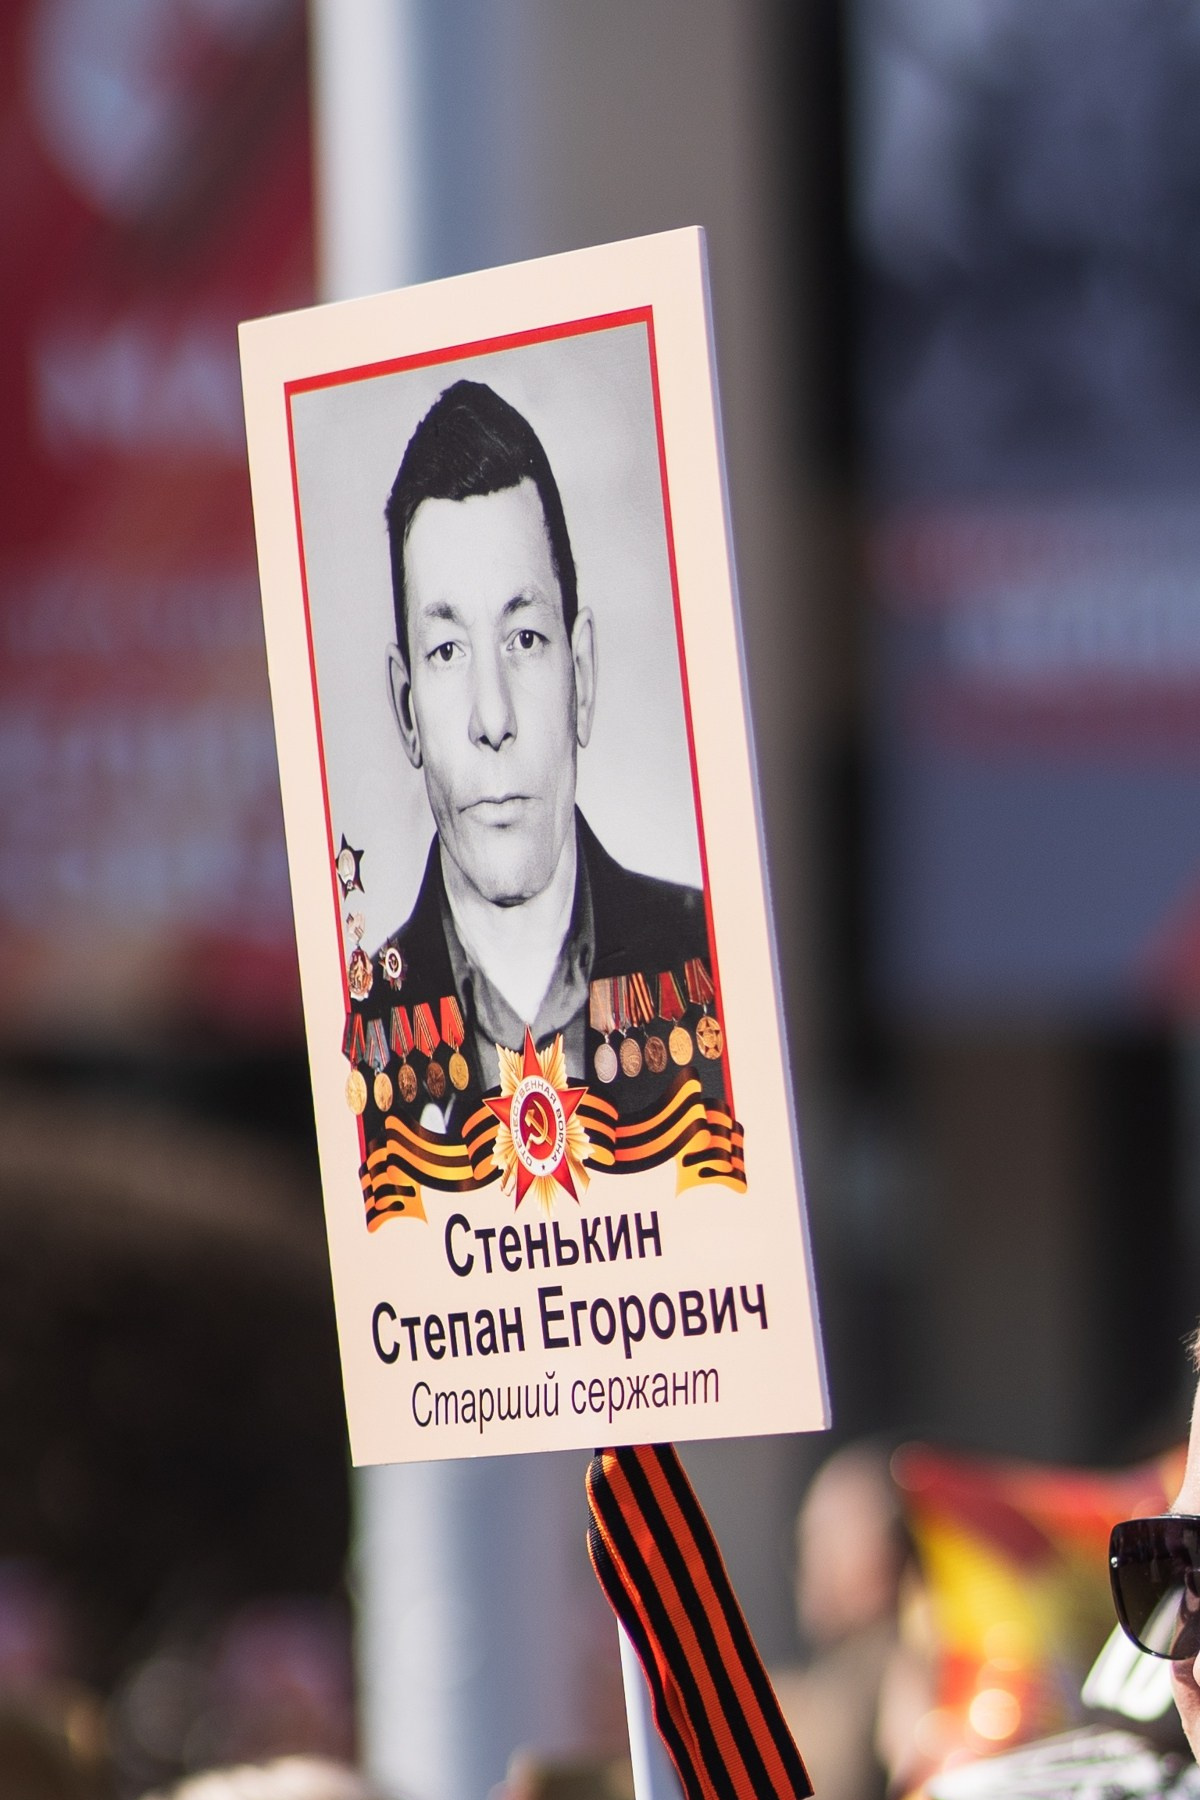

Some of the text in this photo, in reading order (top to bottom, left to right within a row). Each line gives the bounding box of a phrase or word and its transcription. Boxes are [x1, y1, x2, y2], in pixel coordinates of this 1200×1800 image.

[444, 1210, 663, 1278] Стенькин
[371, 1283, 768, 1365] Степан Егорович
[411, 1368, 719, 1435] Старший сержант
